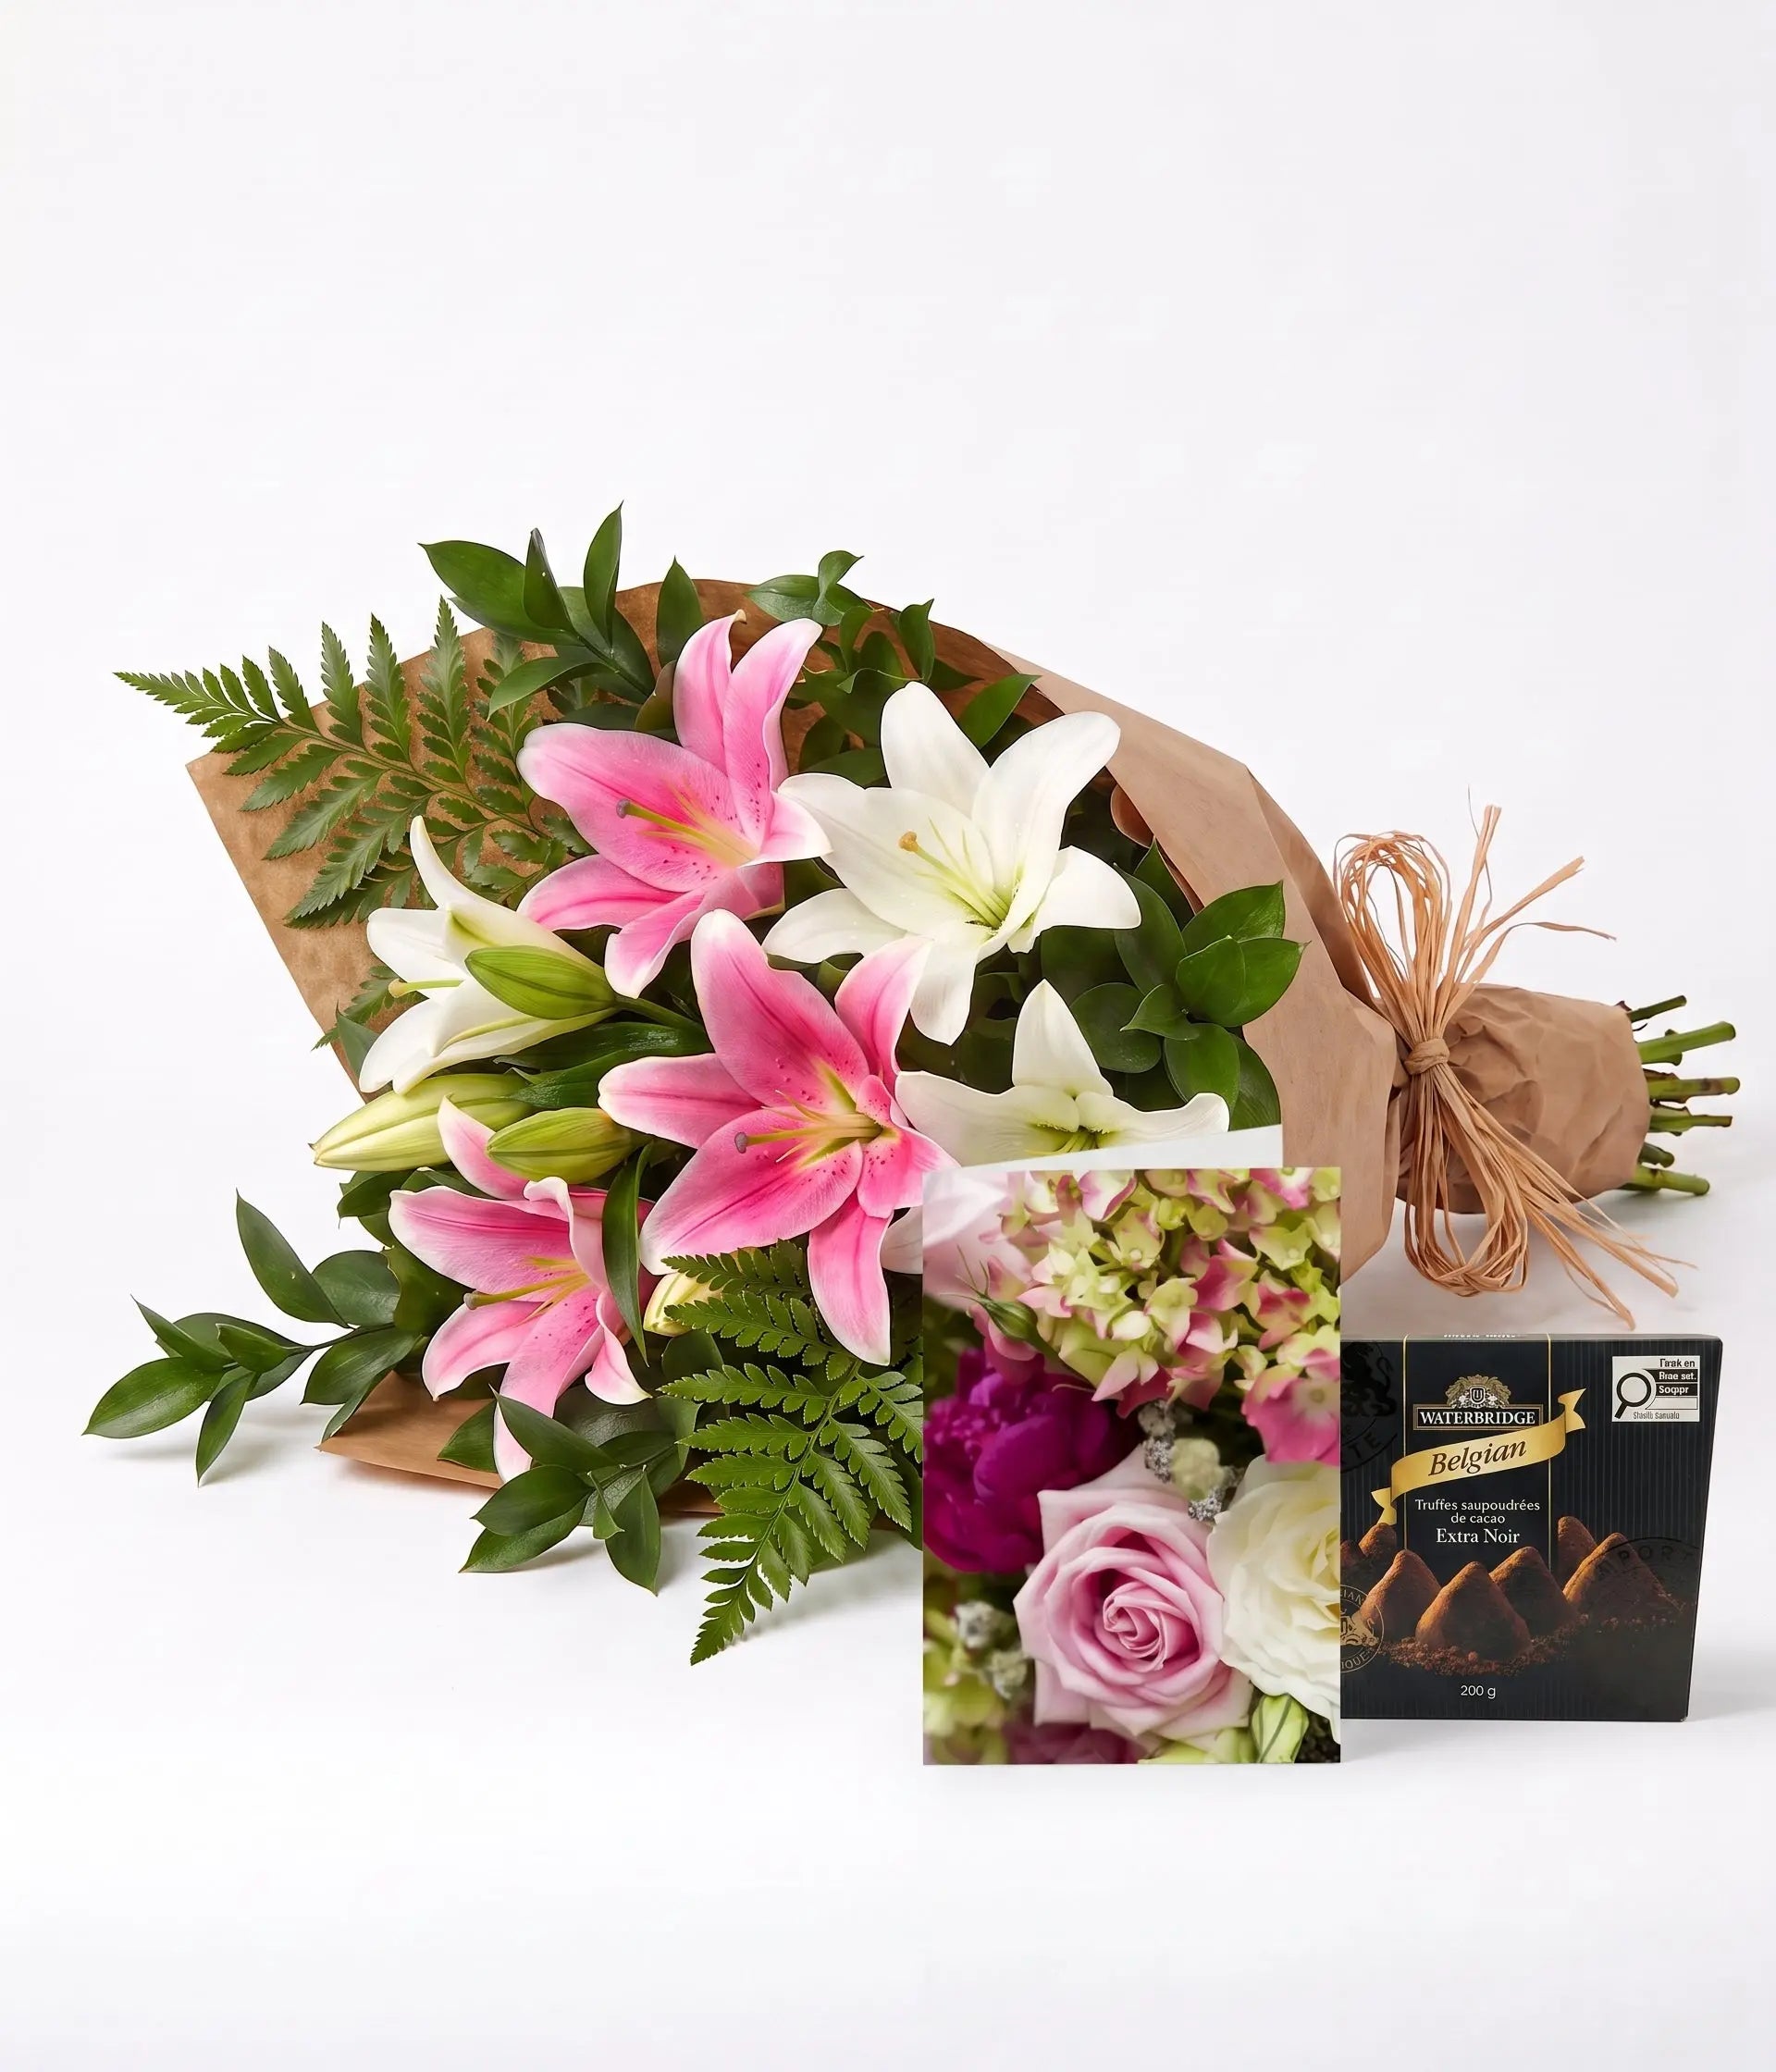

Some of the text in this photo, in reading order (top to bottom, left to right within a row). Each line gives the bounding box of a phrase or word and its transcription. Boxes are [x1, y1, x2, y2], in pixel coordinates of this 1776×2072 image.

[1420, 1411, 1536, 1425] WATERBRIDGE
[1428, 1439, 1526, 1476] Belgian
[1414, 1498, 1540, 1513] Truffes saupoudrées
[1450, 1512, 1505, 1524] de cacao
[1436, 1528, 1521, 1544] Extra Noir
[1461, 1684, 1496, 1699] 200 g
